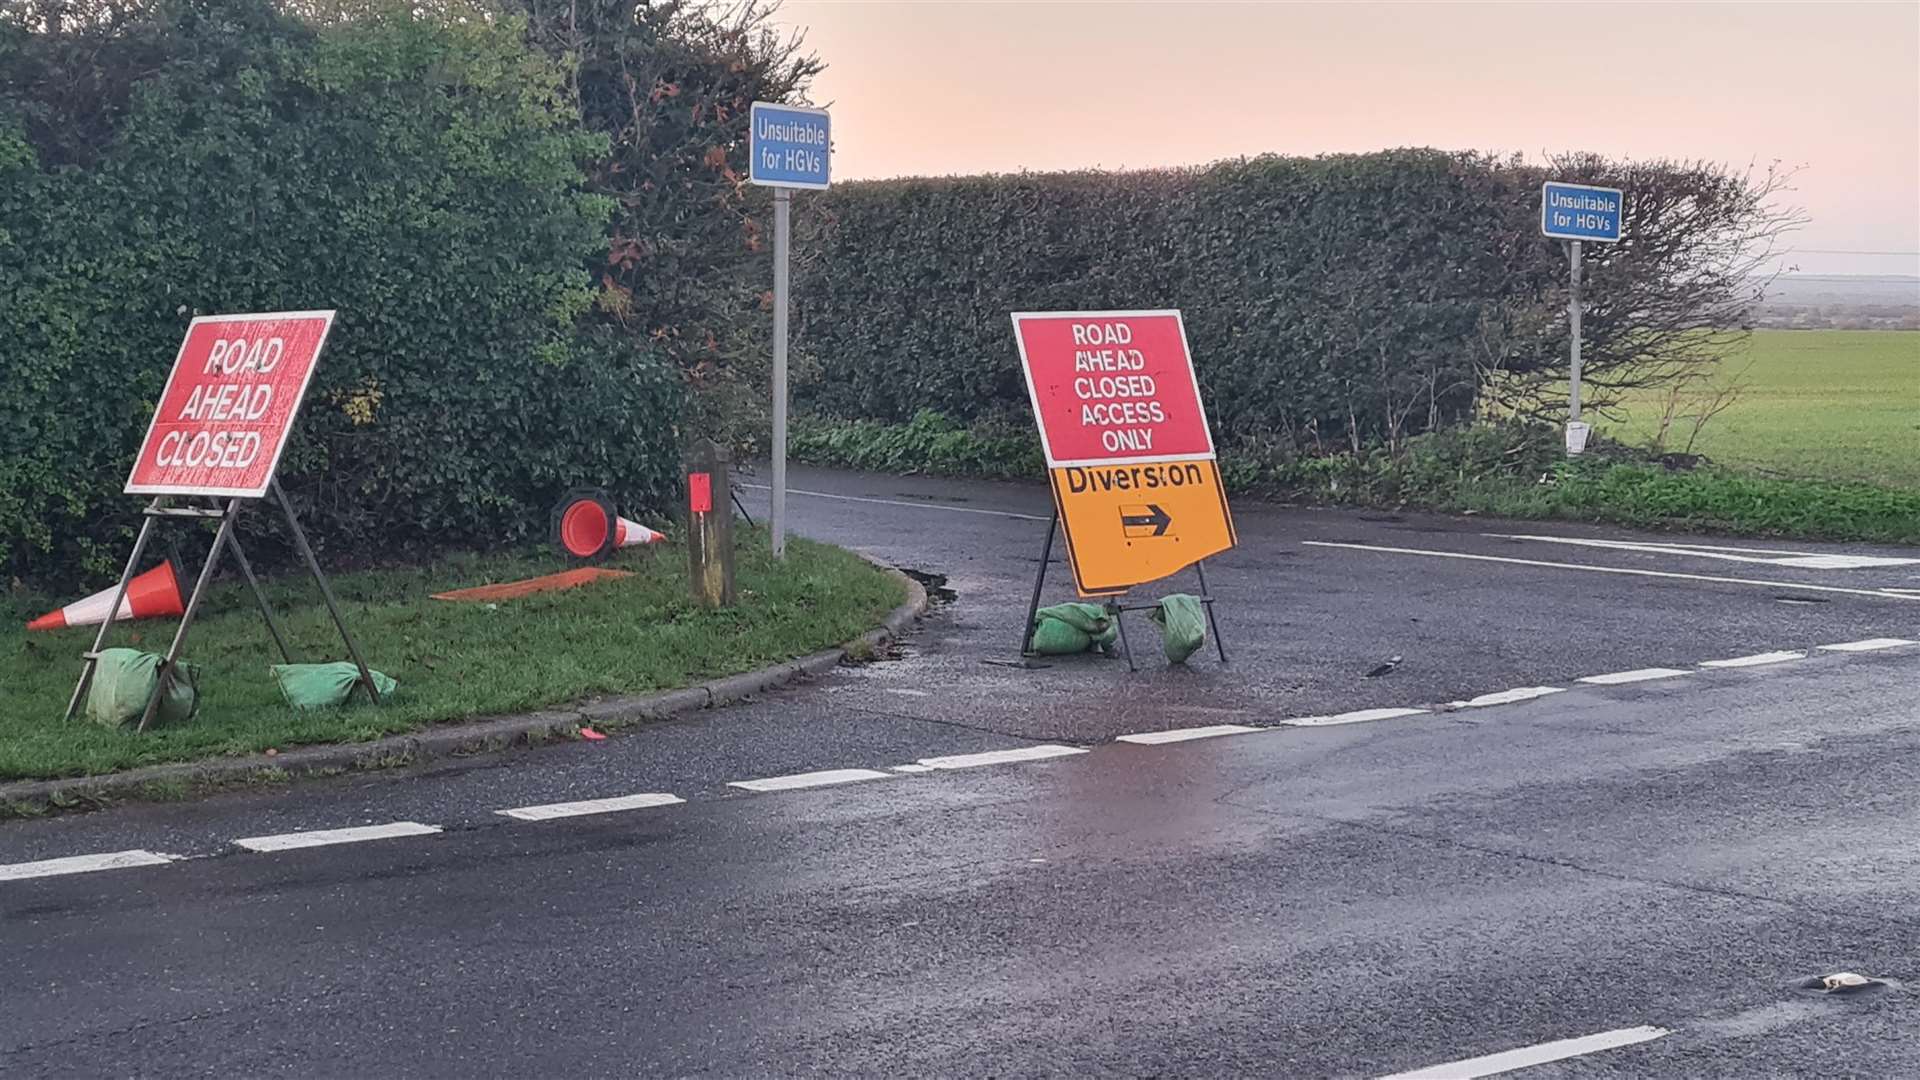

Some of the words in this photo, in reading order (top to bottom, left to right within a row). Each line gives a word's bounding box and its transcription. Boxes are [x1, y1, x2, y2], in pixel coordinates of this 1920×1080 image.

[758, 117, 824, 145] Unsuitable
[762, 146, 780, 169] for
[785, 149, 820, 173] HGVs
[1550, 192, 1616, 212] Unsuitable
[1554, 211, 1571, 227] for
[1576, 213, 1610, 230] HGVs
[1072, 323, 1132, 345] ROAD
[203, 337, 283, 374] ROAD
[1075, 349, 1144, 372] AHEAD
[1074, 375, 1156, 399] CLOSED
[178, 383, 272, 420] AHEAD
[1082, 401, 1165, 426] ACCESS
[155, 430, 261, 468] CLOSED
[1102, 428, 1152, 451] ONLY
[1066, 462, 1202, 494] Diversion
